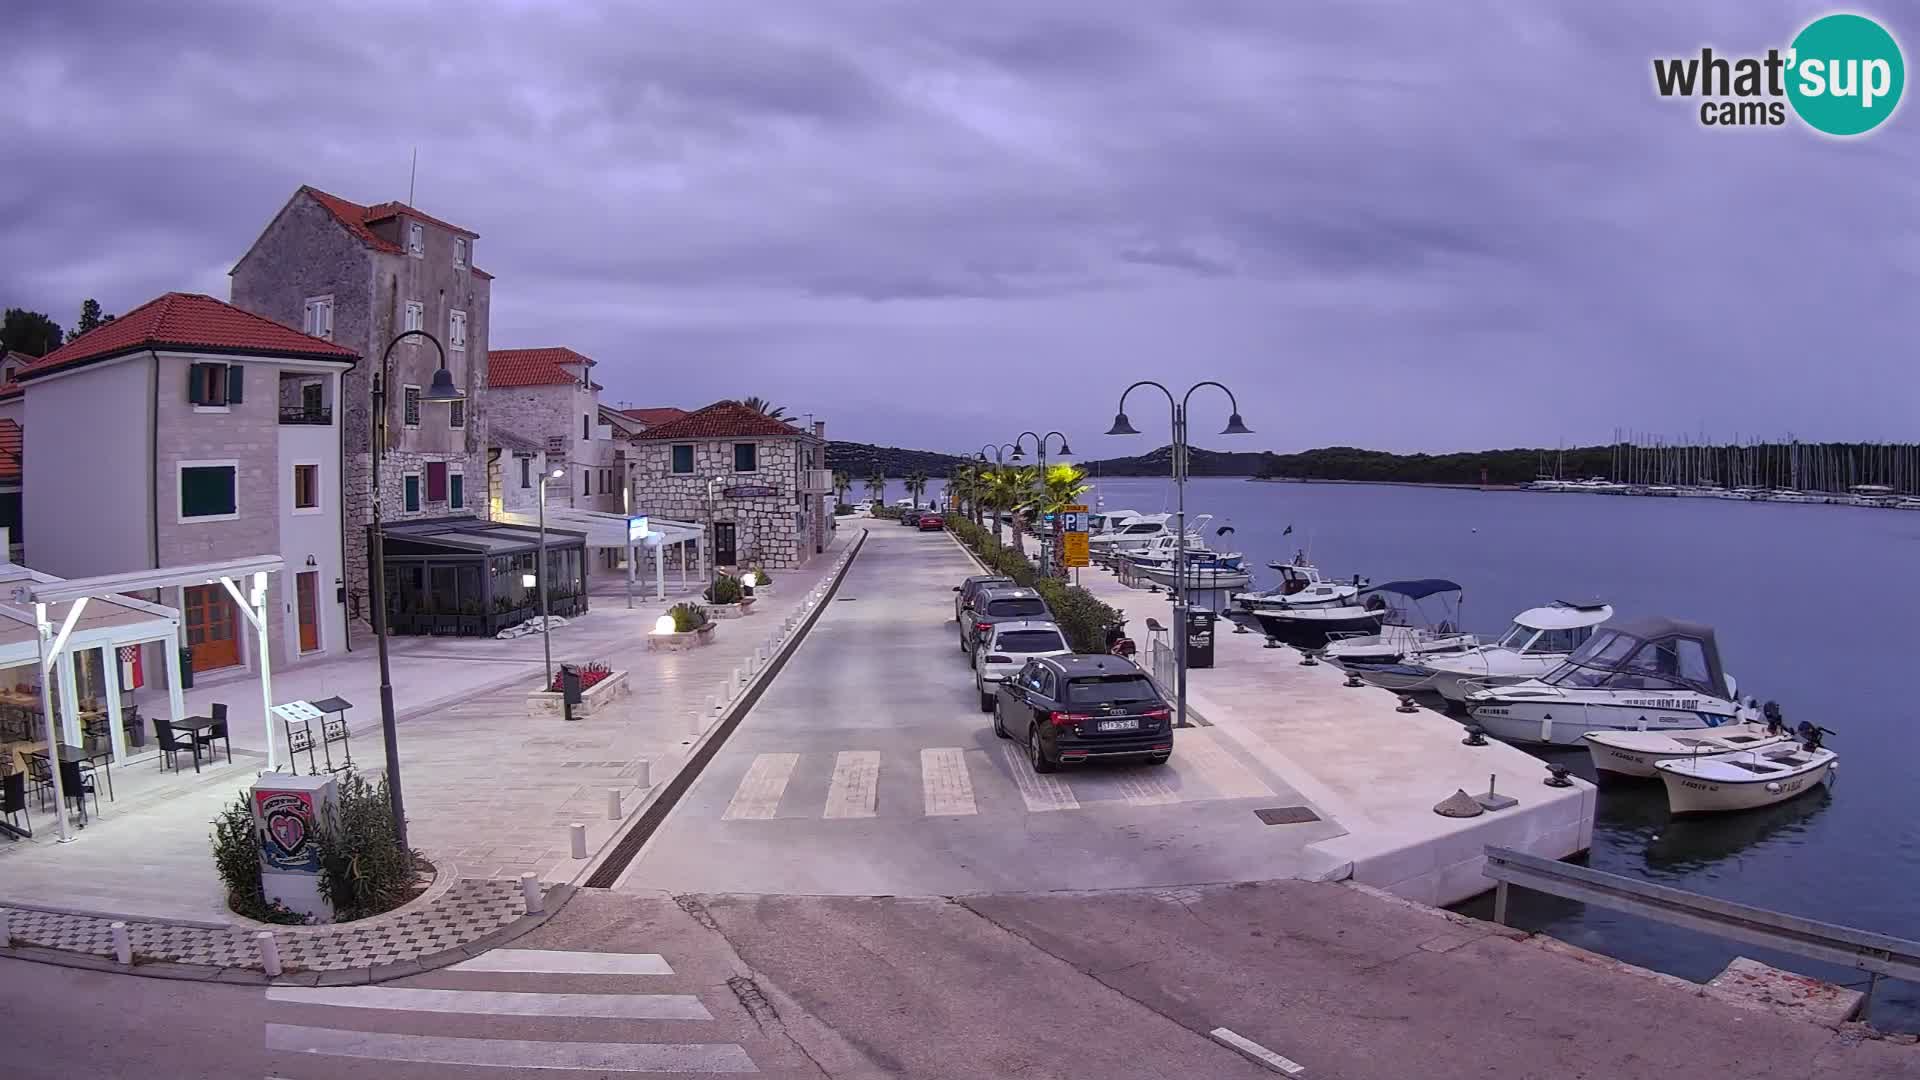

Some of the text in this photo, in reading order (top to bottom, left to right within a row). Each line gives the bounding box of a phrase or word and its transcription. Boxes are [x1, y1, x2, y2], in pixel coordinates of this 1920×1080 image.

[1065, 514, 1076, 530] P
[1656, 699, 1675, 709] RENT
[1681, 699, 1699, 710] BOAT
